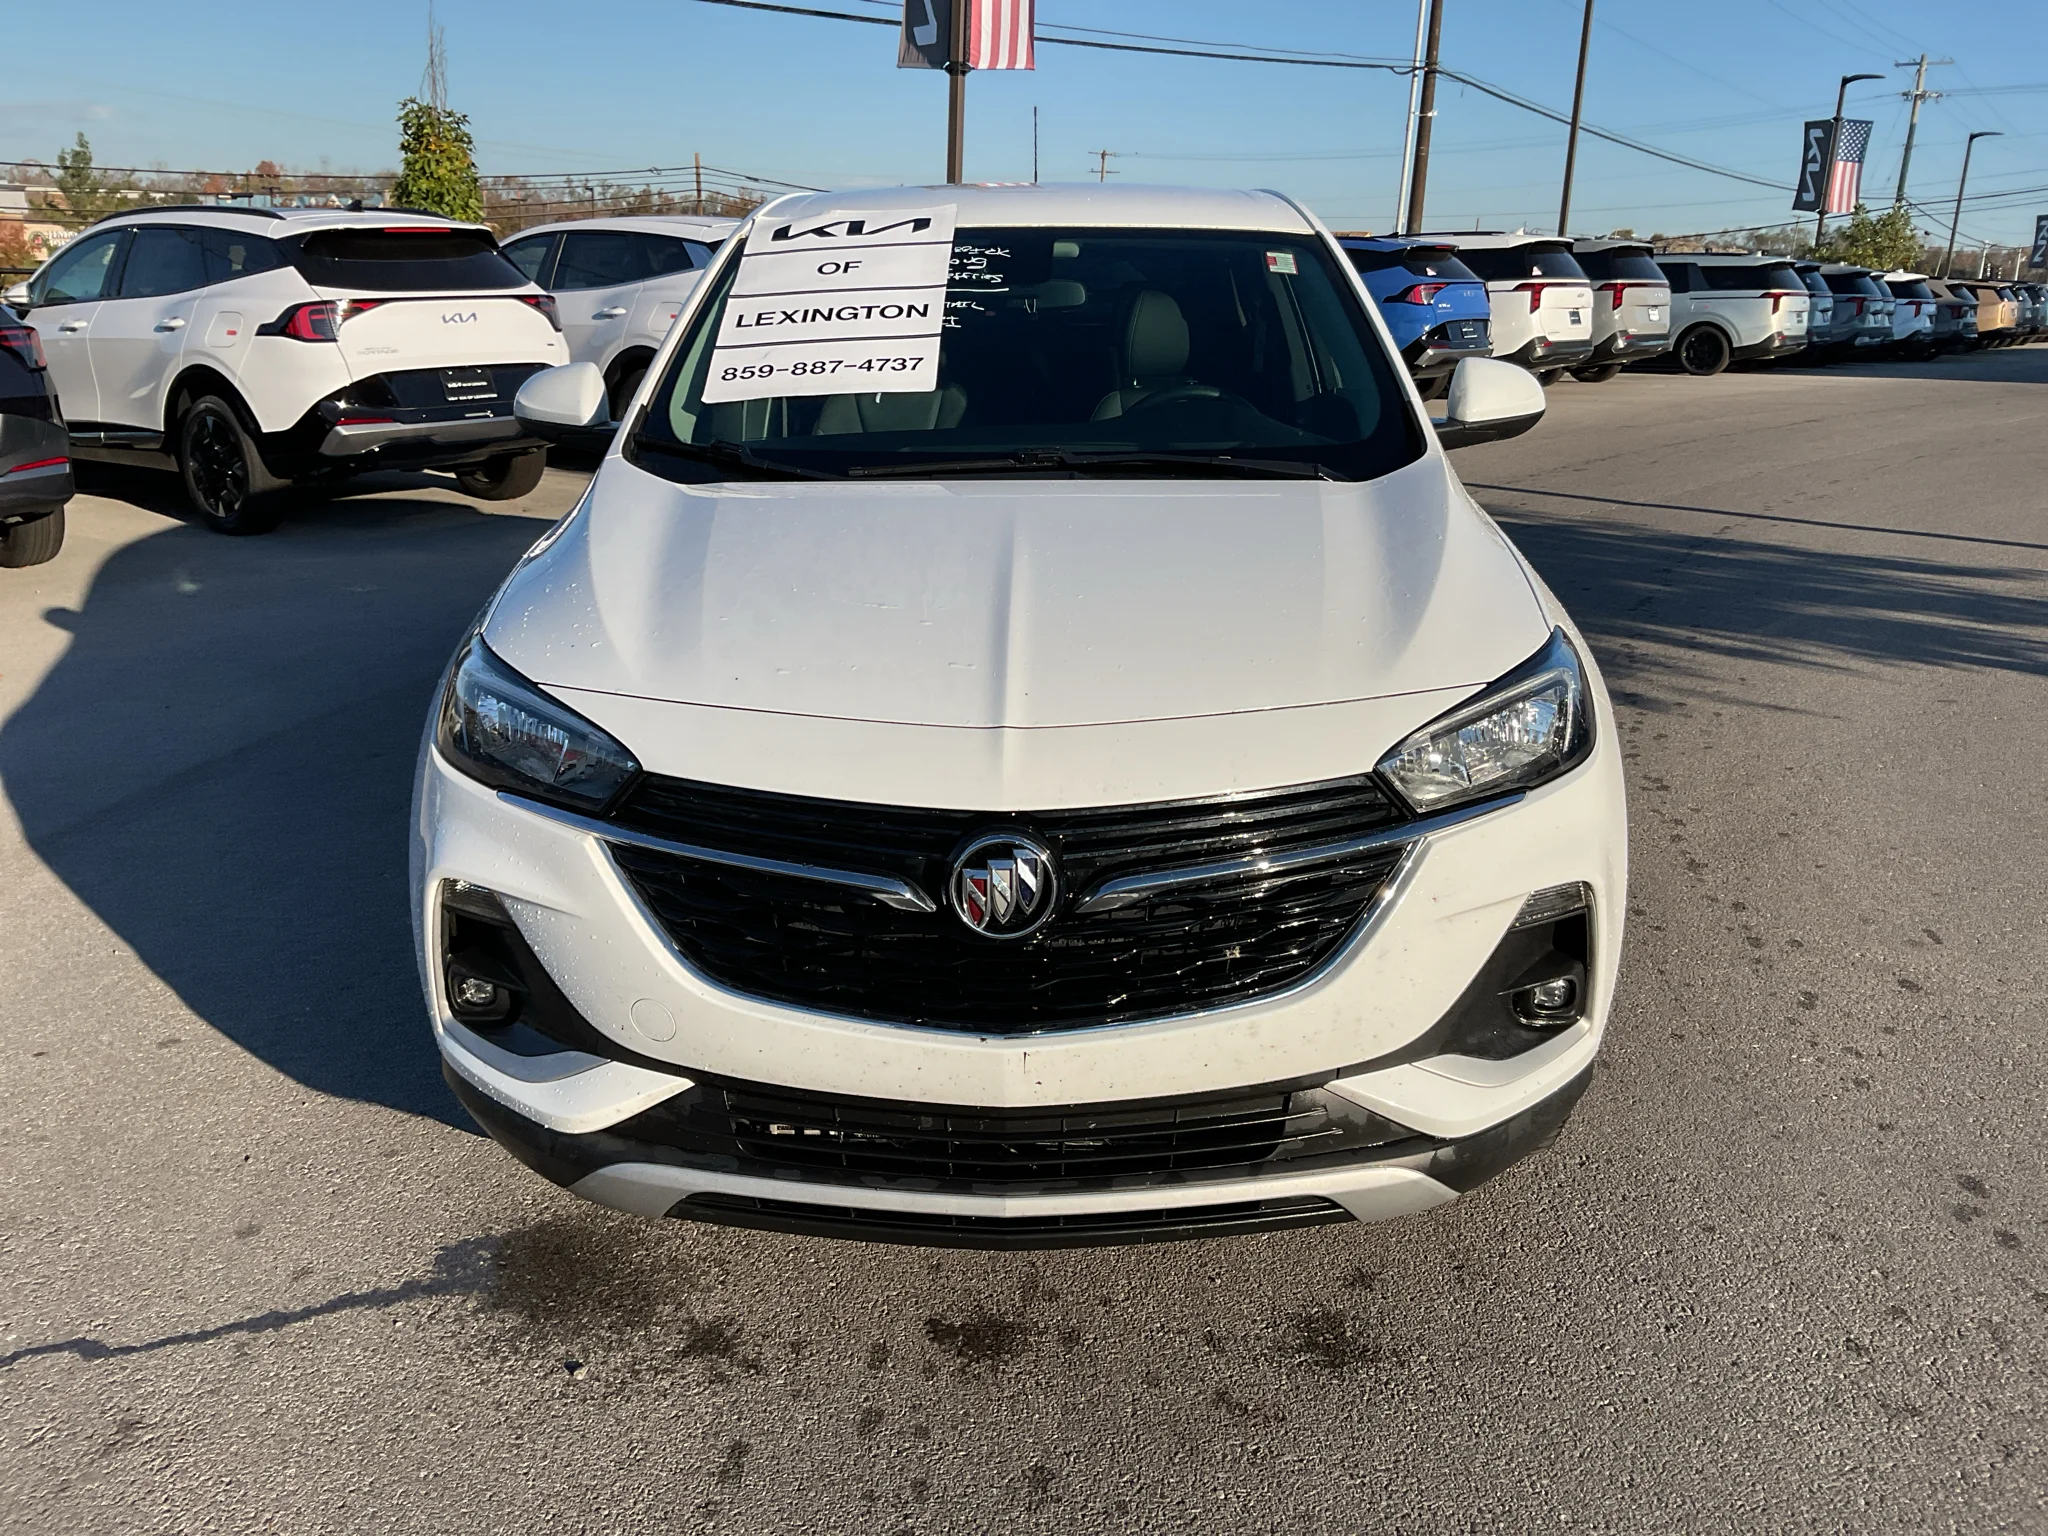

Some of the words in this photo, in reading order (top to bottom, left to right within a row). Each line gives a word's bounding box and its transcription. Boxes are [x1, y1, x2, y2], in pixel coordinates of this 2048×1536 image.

[771, 217, 932, 242] KIA
[817, 260, 863, 275] OF
[441, 312, 478, 324] KIA
[735, 303, 929, 328] LEXINGTON
[721, 357, 924, 381] 859-887-4737
